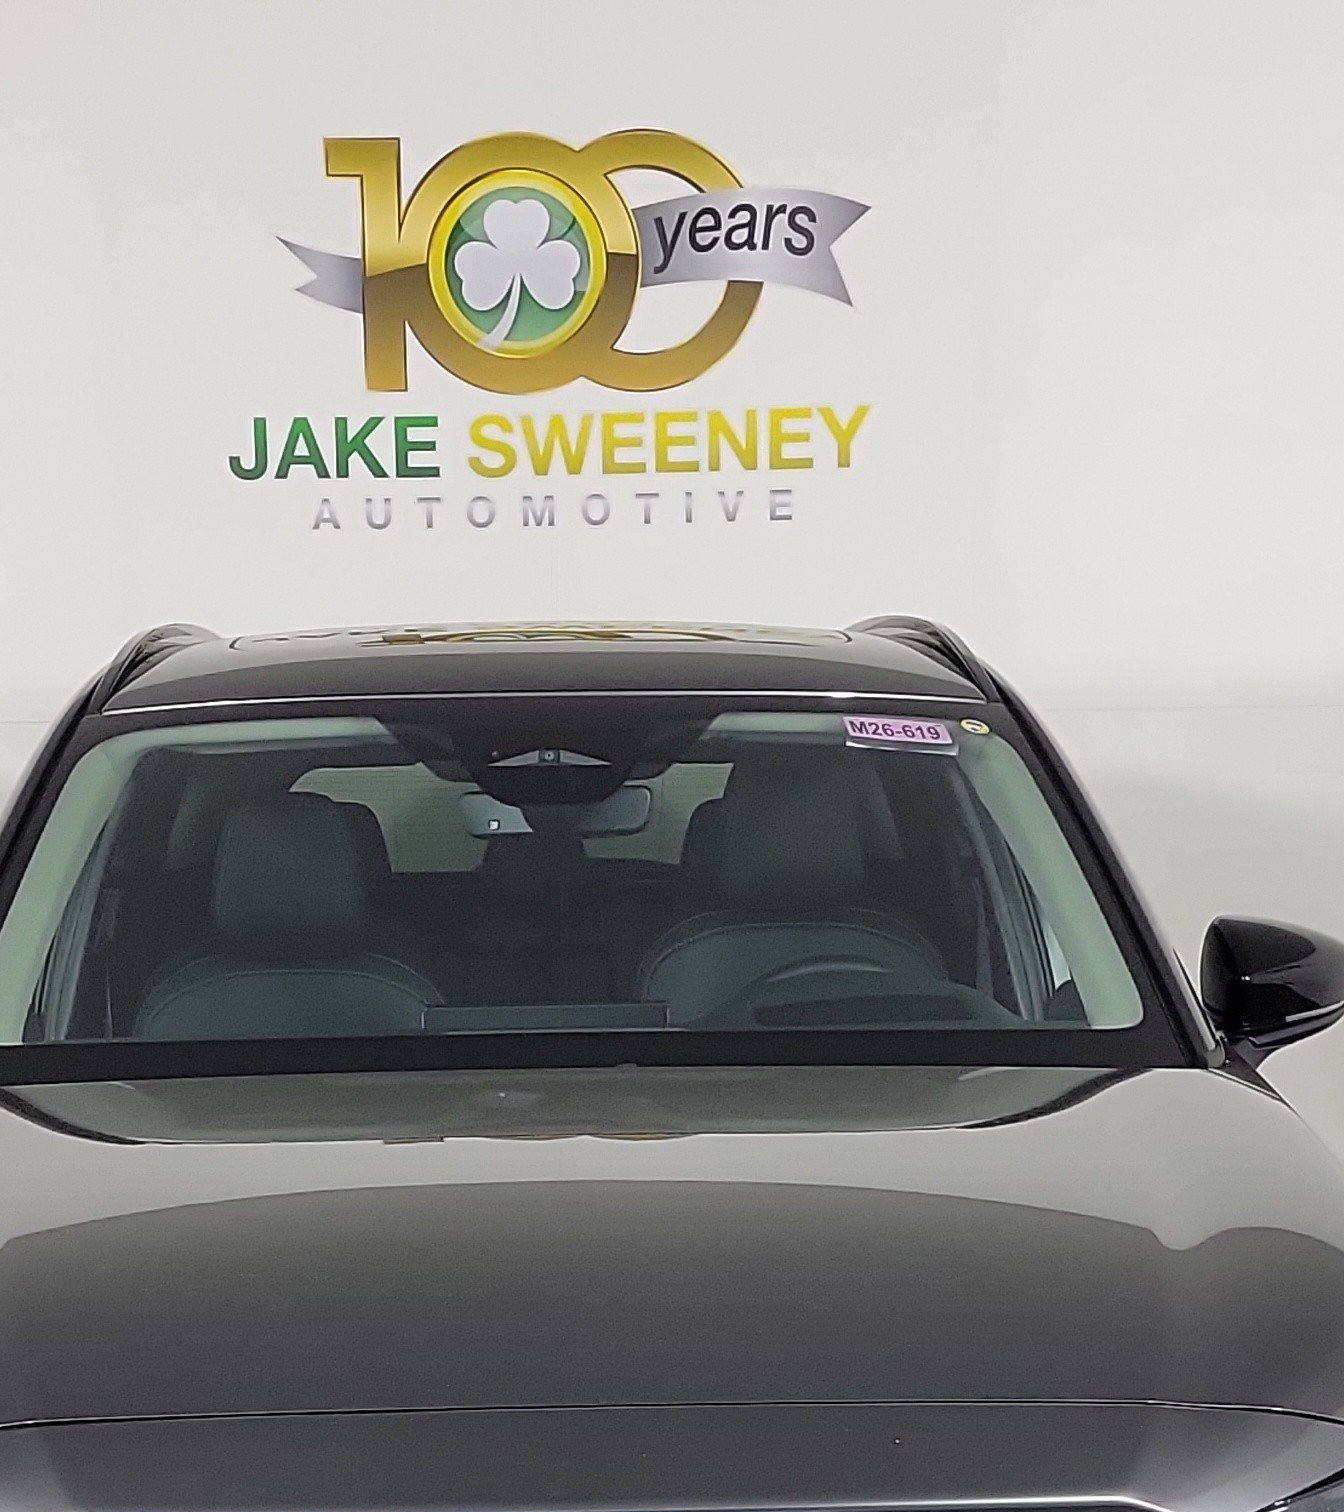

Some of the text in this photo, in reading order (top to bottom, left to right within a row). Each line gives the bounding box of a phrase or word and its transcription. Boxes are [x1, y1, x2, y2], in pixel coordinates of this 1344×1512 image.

[324, 128, 818, 395] 100 years
[229, 405, 870, 481] JAKE SWEENEY
[311, 489, 794, 530] AUTOMOTIVE
[849, 720, 941, 740] M26-619
